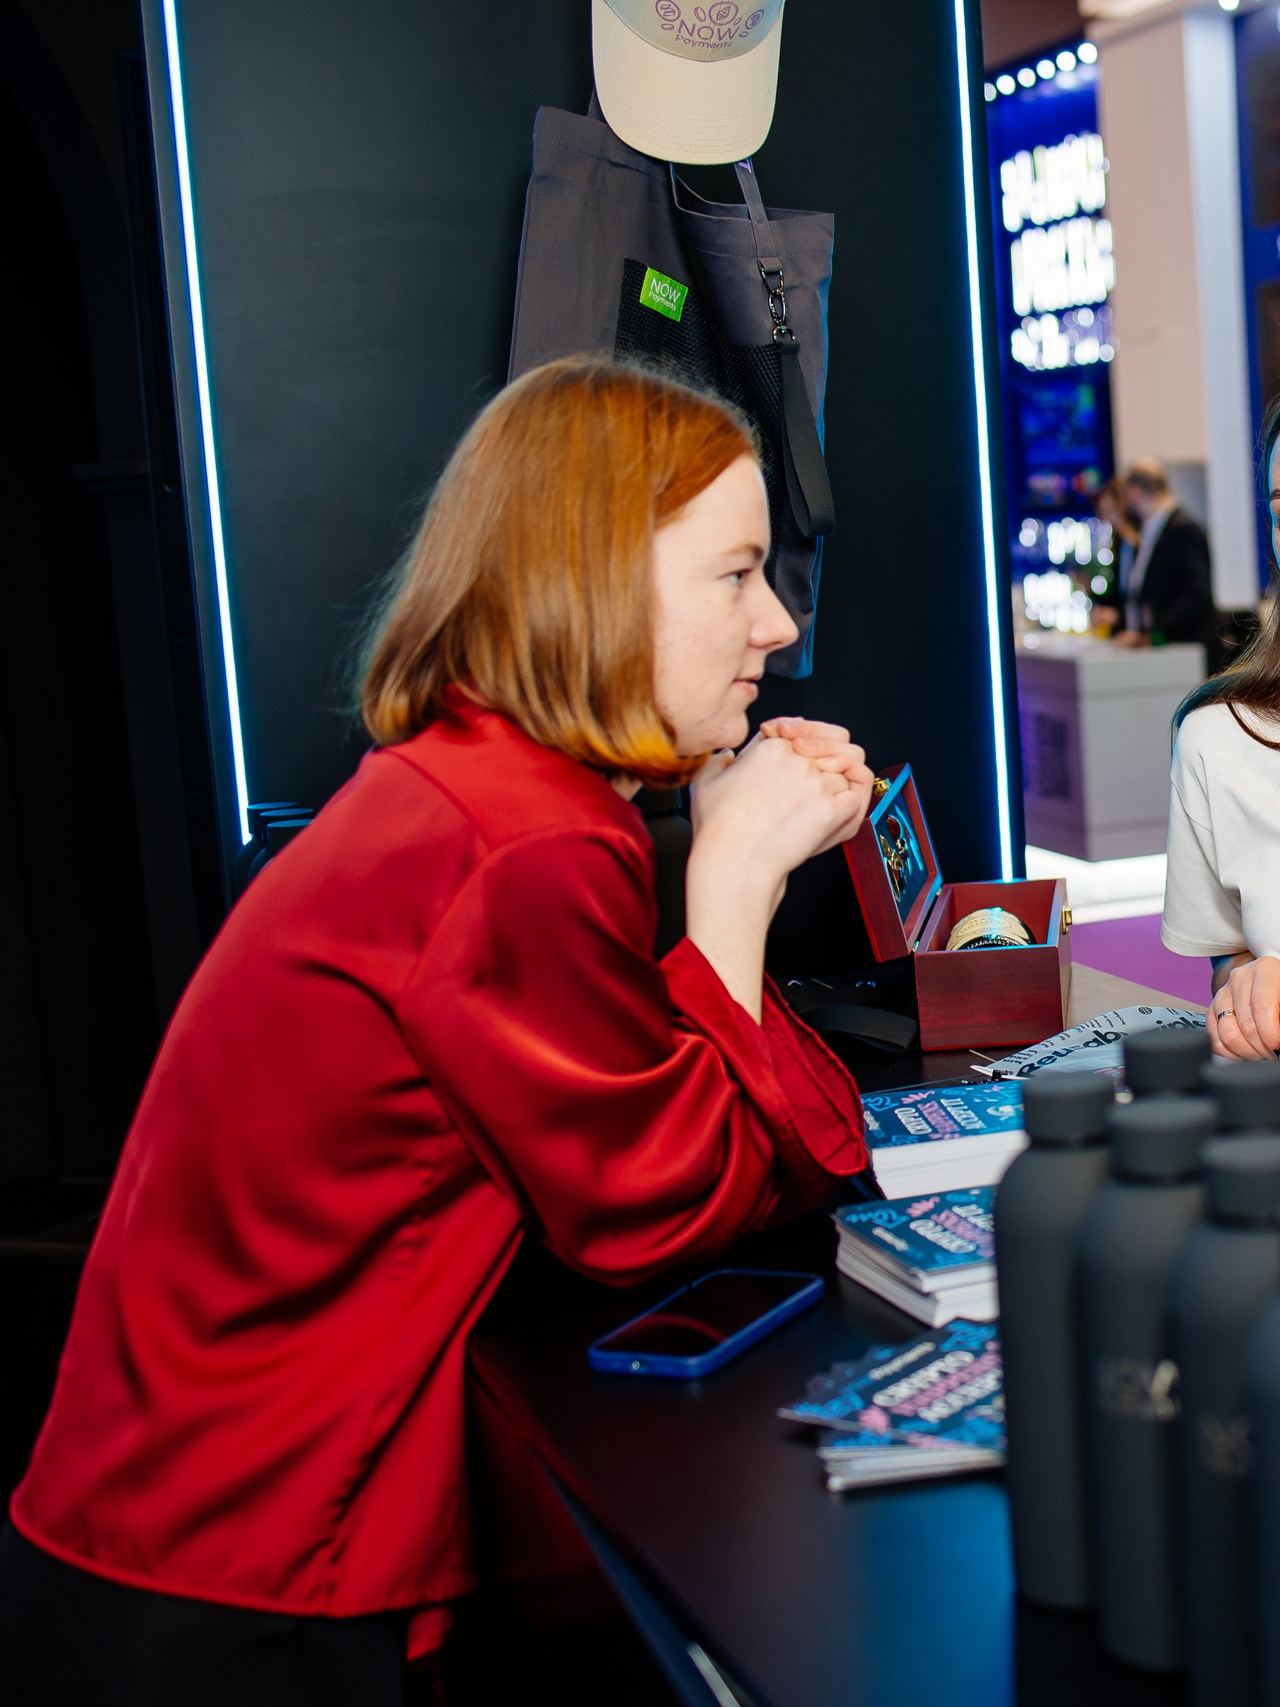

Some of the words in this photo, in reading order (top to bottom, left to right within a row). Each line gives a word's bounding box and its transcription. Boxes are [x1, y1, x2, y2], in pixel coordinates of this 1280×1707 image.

[678, 19, 740, 41] NOW
[675, 34, 733, 48] Payments
[648, 290, 677, 311] Payments
[650, 277, 681, 303] NOW
